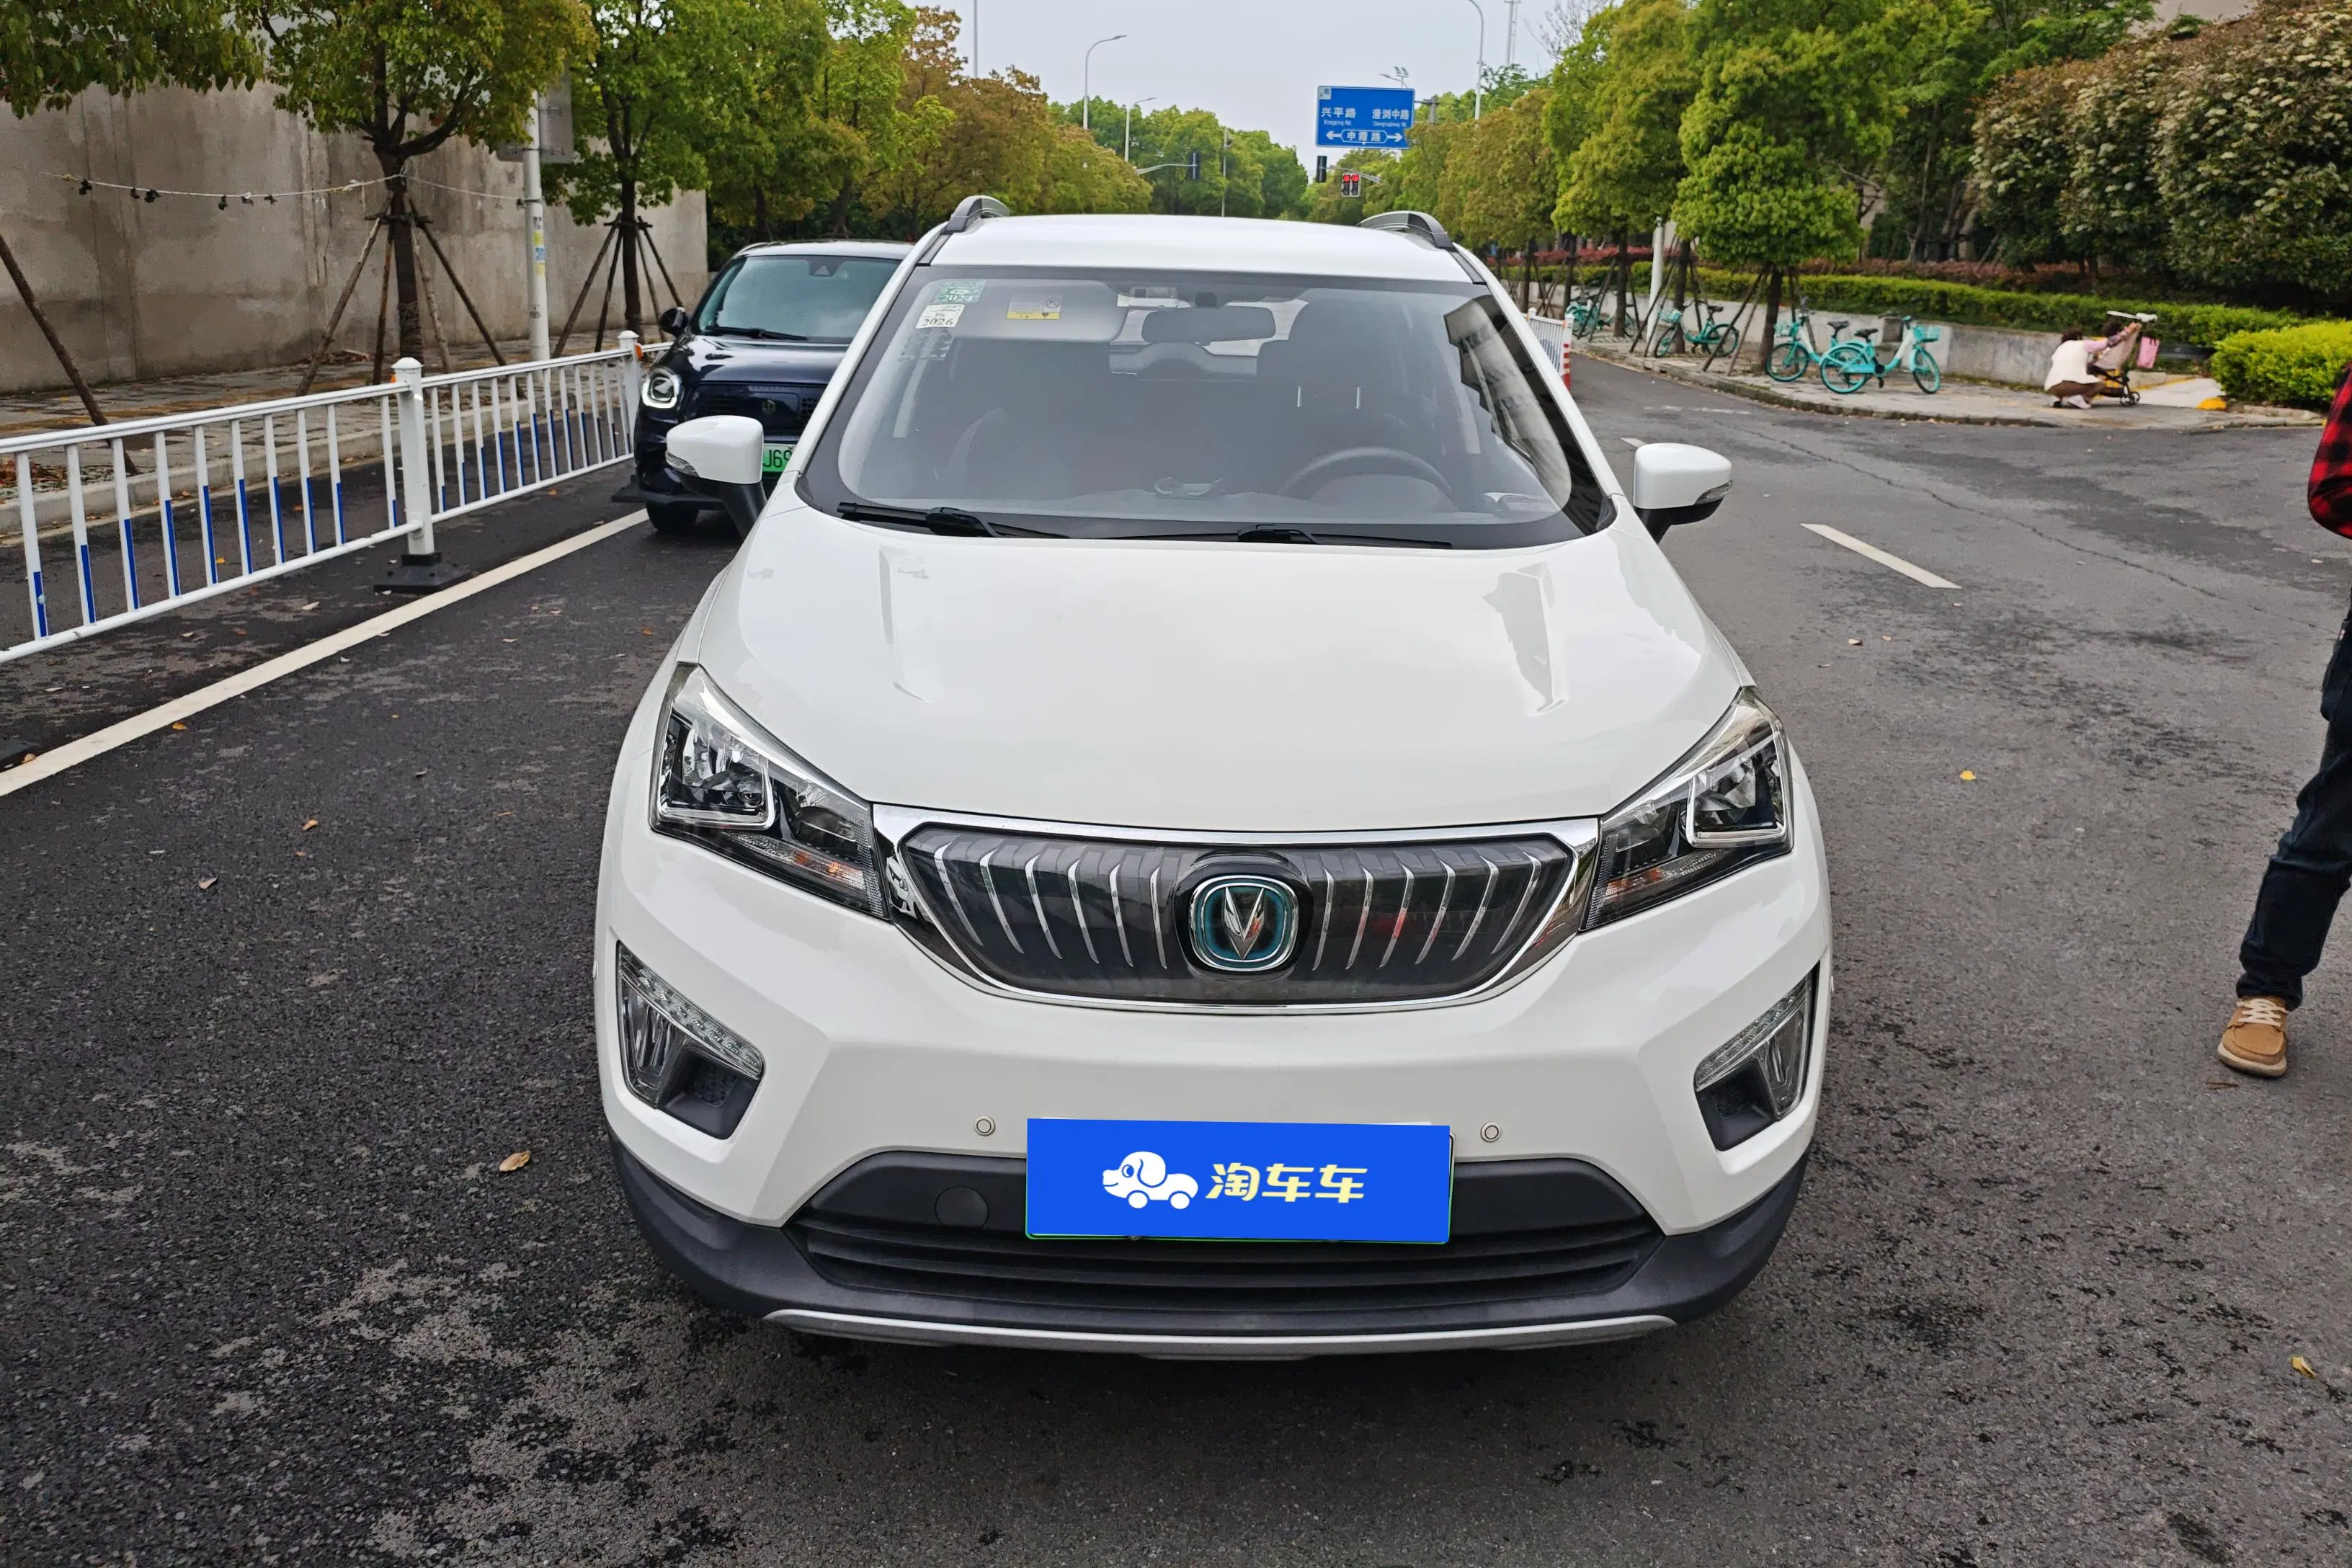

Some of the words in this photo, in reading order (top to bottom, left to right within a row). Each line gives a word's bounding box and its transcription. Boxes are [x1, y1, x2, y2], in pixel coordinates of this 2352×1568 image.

[1321, 107, 1356, 119] 兴平路
[922, 317, 955, 326] 2026
